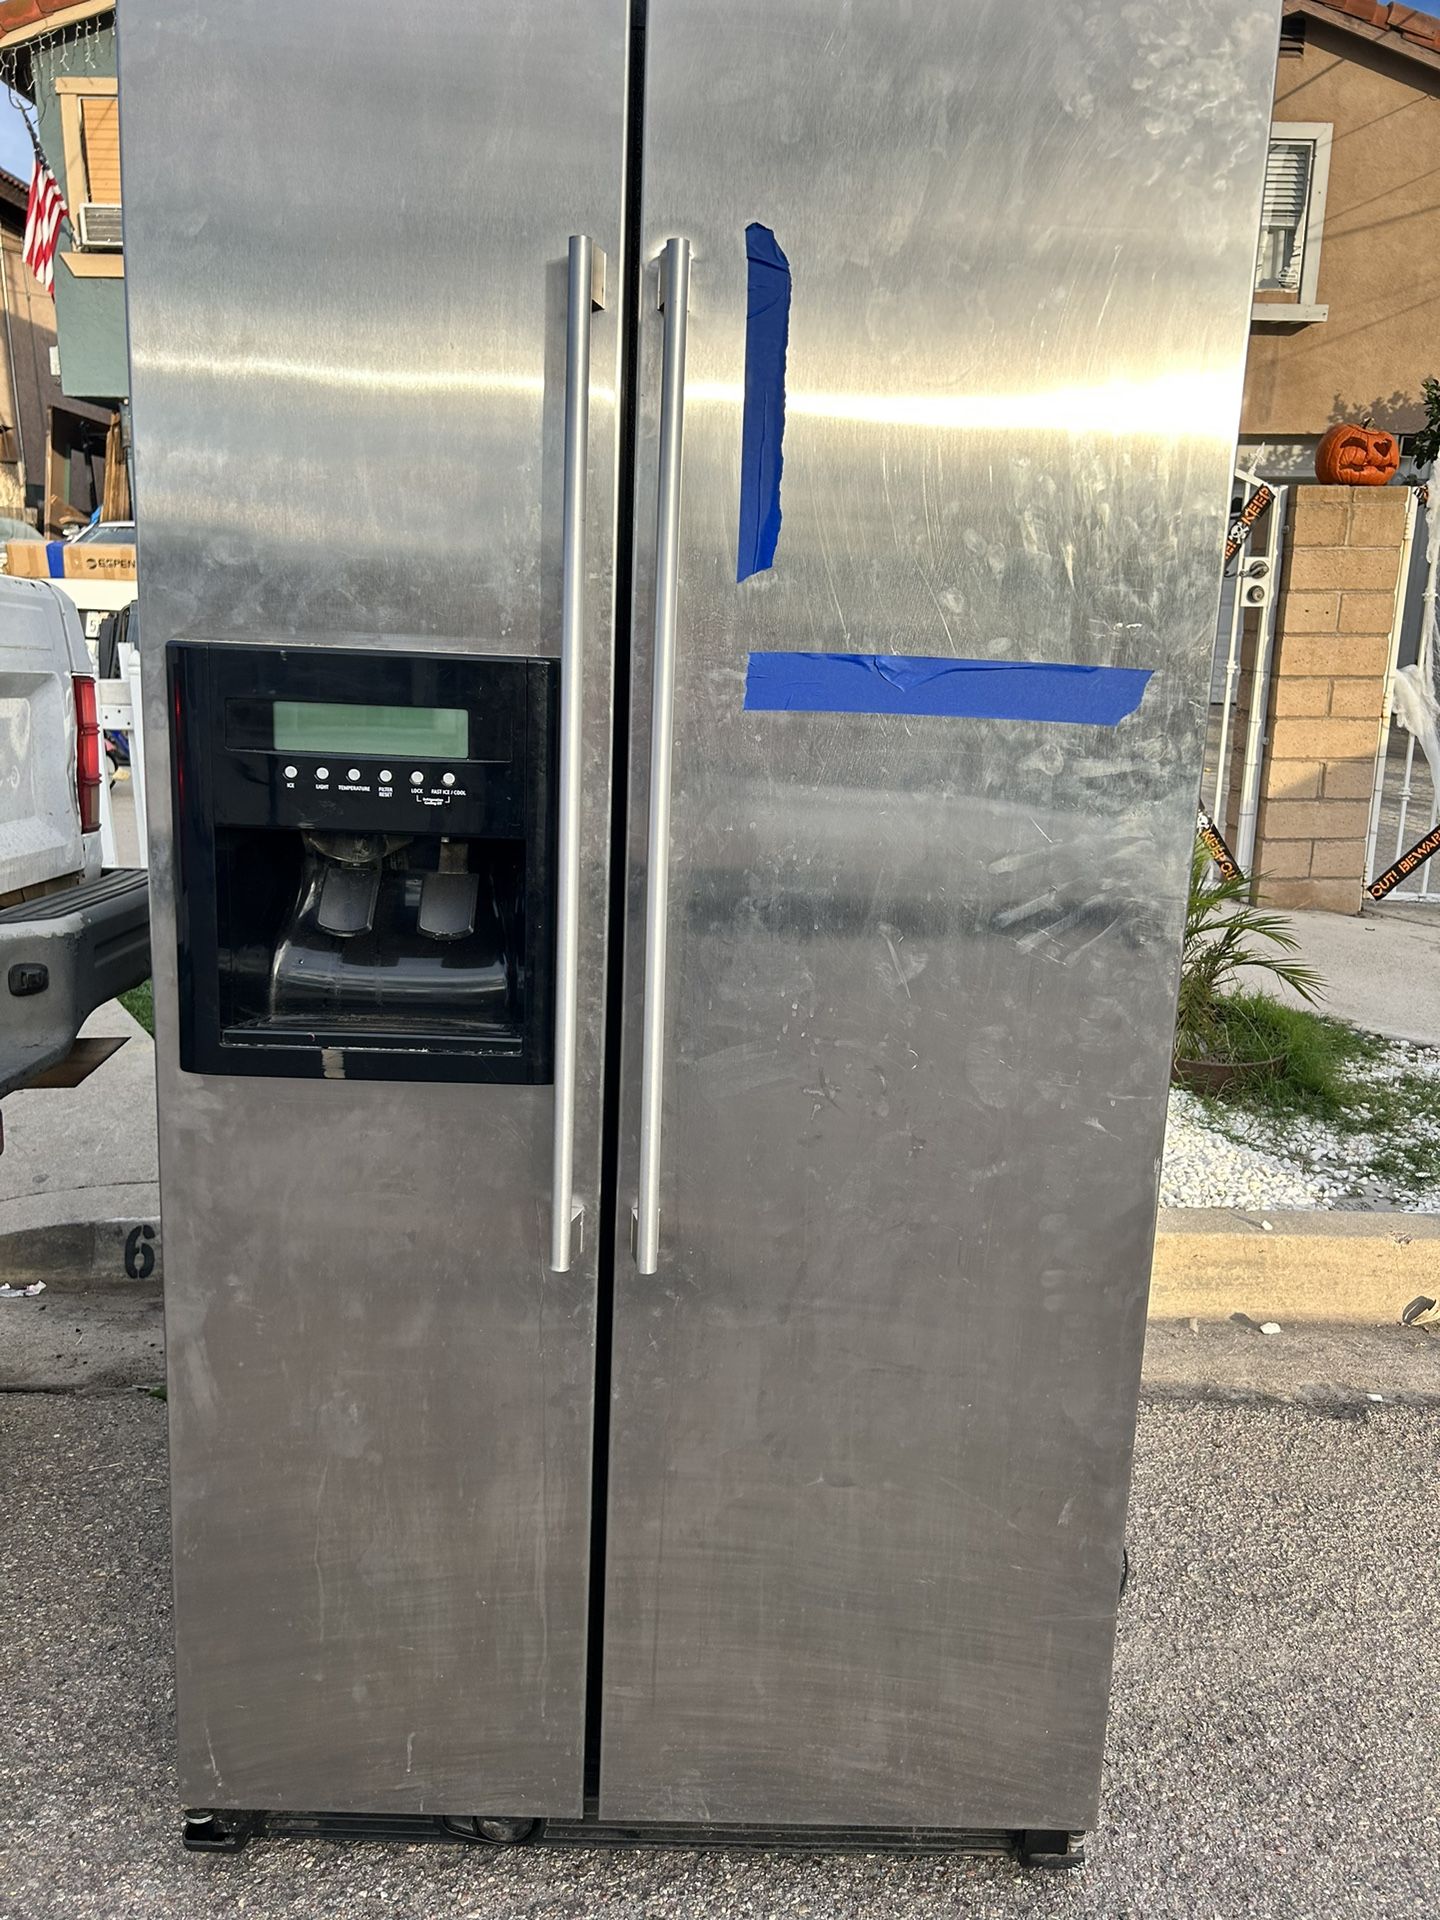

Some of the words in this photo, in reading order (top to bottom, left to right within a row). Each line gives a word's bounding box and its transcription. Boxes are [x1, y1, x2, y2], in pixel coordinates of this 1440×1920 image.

[1241, 485, 1270, 526] KEEP
[98, 559, 135, 569] ESPEN
[338, 784, 371, 792] TEMPERATURE
[1220, 862, 1238, 881] OU
[1371, 869, 1400, 897] OUT!
[1397, 829, 1440, 874] BEWAR
[124, 1224, 156, 1280] 6
